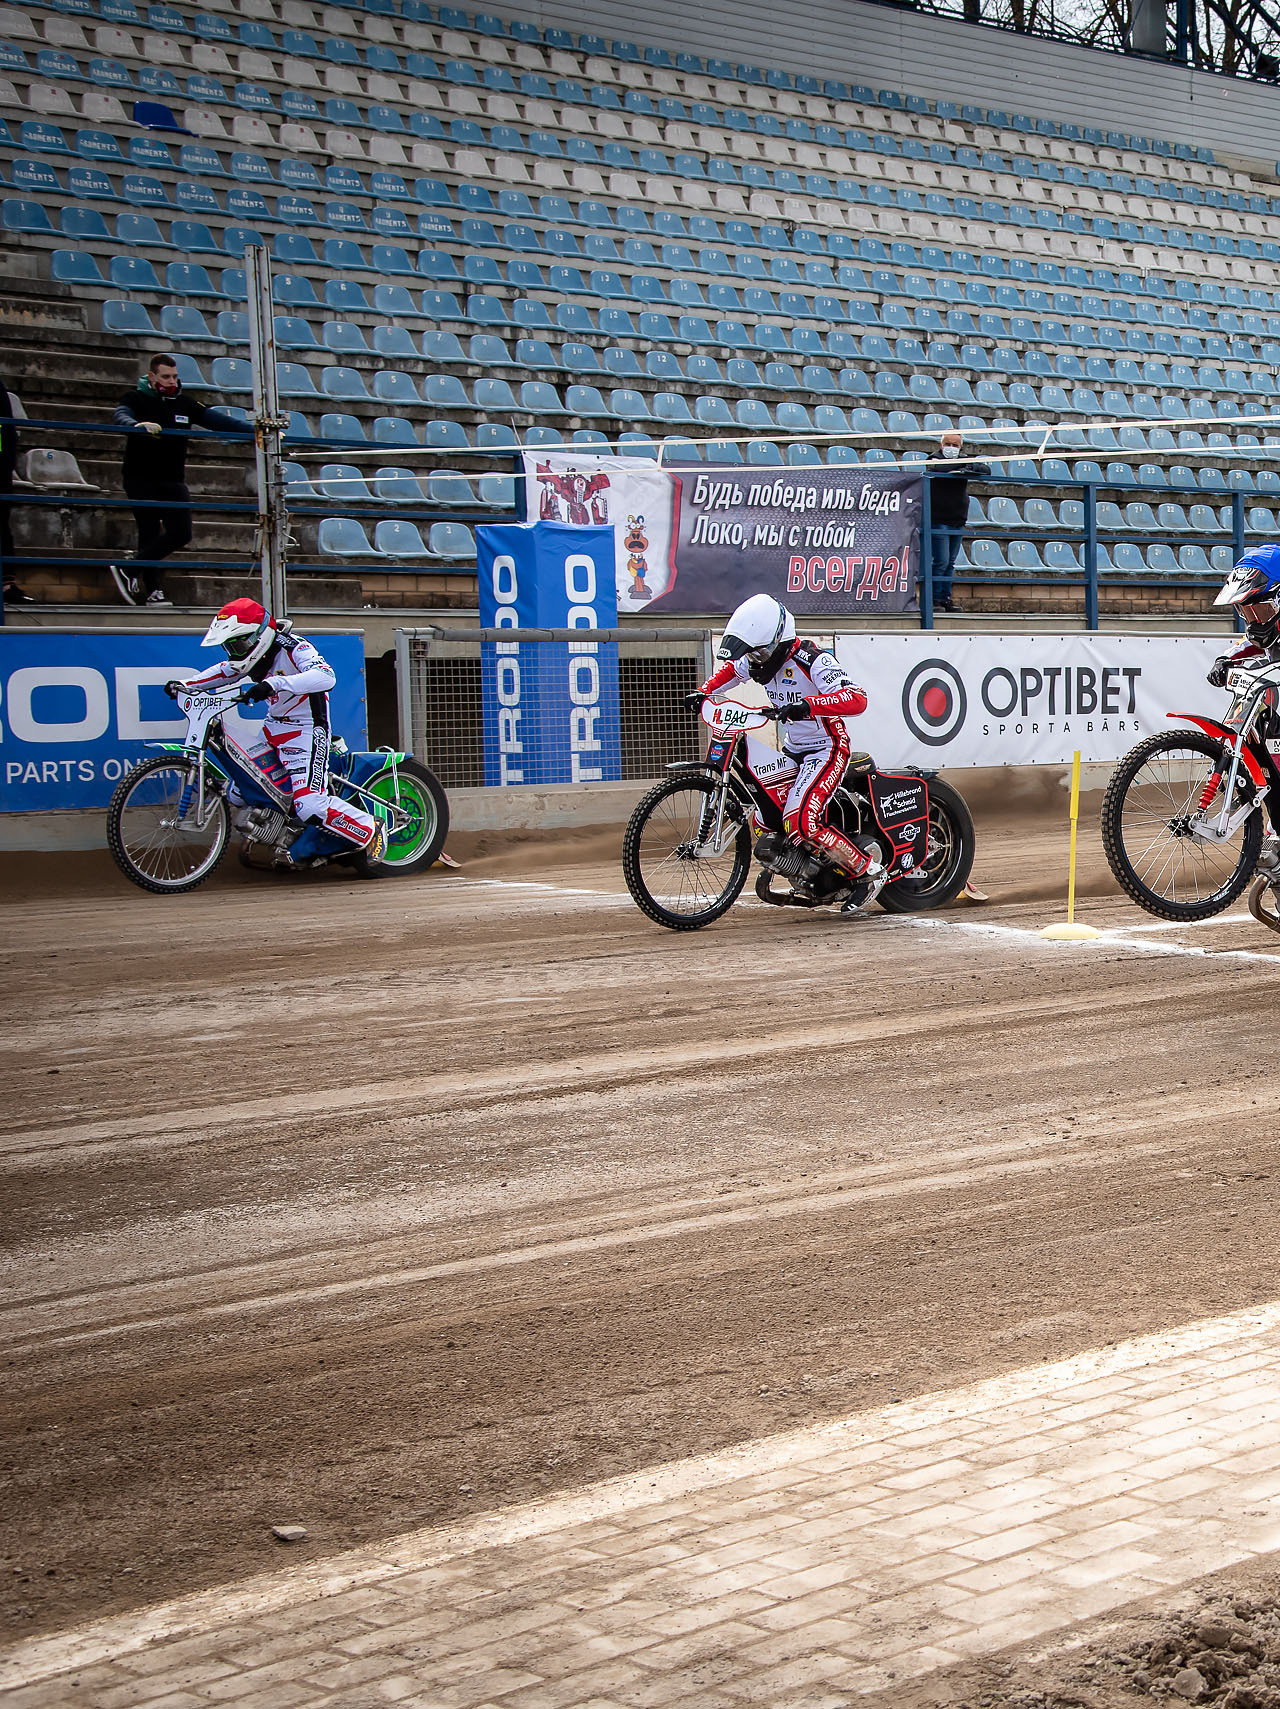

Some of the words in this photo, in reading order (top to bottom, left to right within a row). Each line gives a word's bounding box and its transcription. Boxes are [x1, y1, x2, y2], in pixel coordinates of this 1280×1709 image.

[28, 162, 35, 172] 2
[85, 171, 92, 180] 3
[20, 202, 26, 211] 1
[291, 197, 297, 206] 7
[337, 241, 344, 249] 7
[69, 252, 75, 262] 1
[128, 259, 136, 269] 2
[183, 265, 190, 274] 3
[285, 276, 292, 286] 5
[340, 283, 347, 291] 6
[388, 287, 394, 295] 7
[336, 324, 343, 333] 5
[436, 332, 443, 342] 7
[800, 331, 809, 339] 17
[615, 350, 624, 359] 11
[656, 354, 667, 363] 12
[229, 360, 236, 370] 2
[775, 366, 784, 374] 15
[390, 374, 397, 384] 5
[439, 377, 446, 386] 6
[488, 381, 495, 390] 7
[666, 395, 675, 404] 11
[440, 425, 447, 434] 5
[490, 427, 497, 436] 6
[537, 429, 545, 439] 7
[758, 444, 768, 453] 12
[336, 468, 343, 477] 2
[692, 474, 743, 511] Будь
[747, 478, 817, 513] победа
[821, 487, 854, 510] иль
[858, 483, 900, 516] беда
[691, 515, 749, 550] Локо,
[753, 524, 785, 546] мы
[788, 525, 801, 547] с
[804, 520, 857, 548] тобой
[786, 545, 910, 601] всегда!
[492, 554, 524, 787] TRODO
[564, 553, 603, 784] TRODO
[981, 666, 1142, 718] OPTIBET
[193, 697, 224, 707] OPTIBET
[808, 694, 839, 706] Trans
[724, 709, 749, 724] BAU
[982, 722, 1071, 736] SPORTA
[1087, 718, 1140, 733] BĀRS
[753, 762, 776, 776] Trans
[775, 756, 787, 770] MF
[6, 760, 95, 784] PARTS
